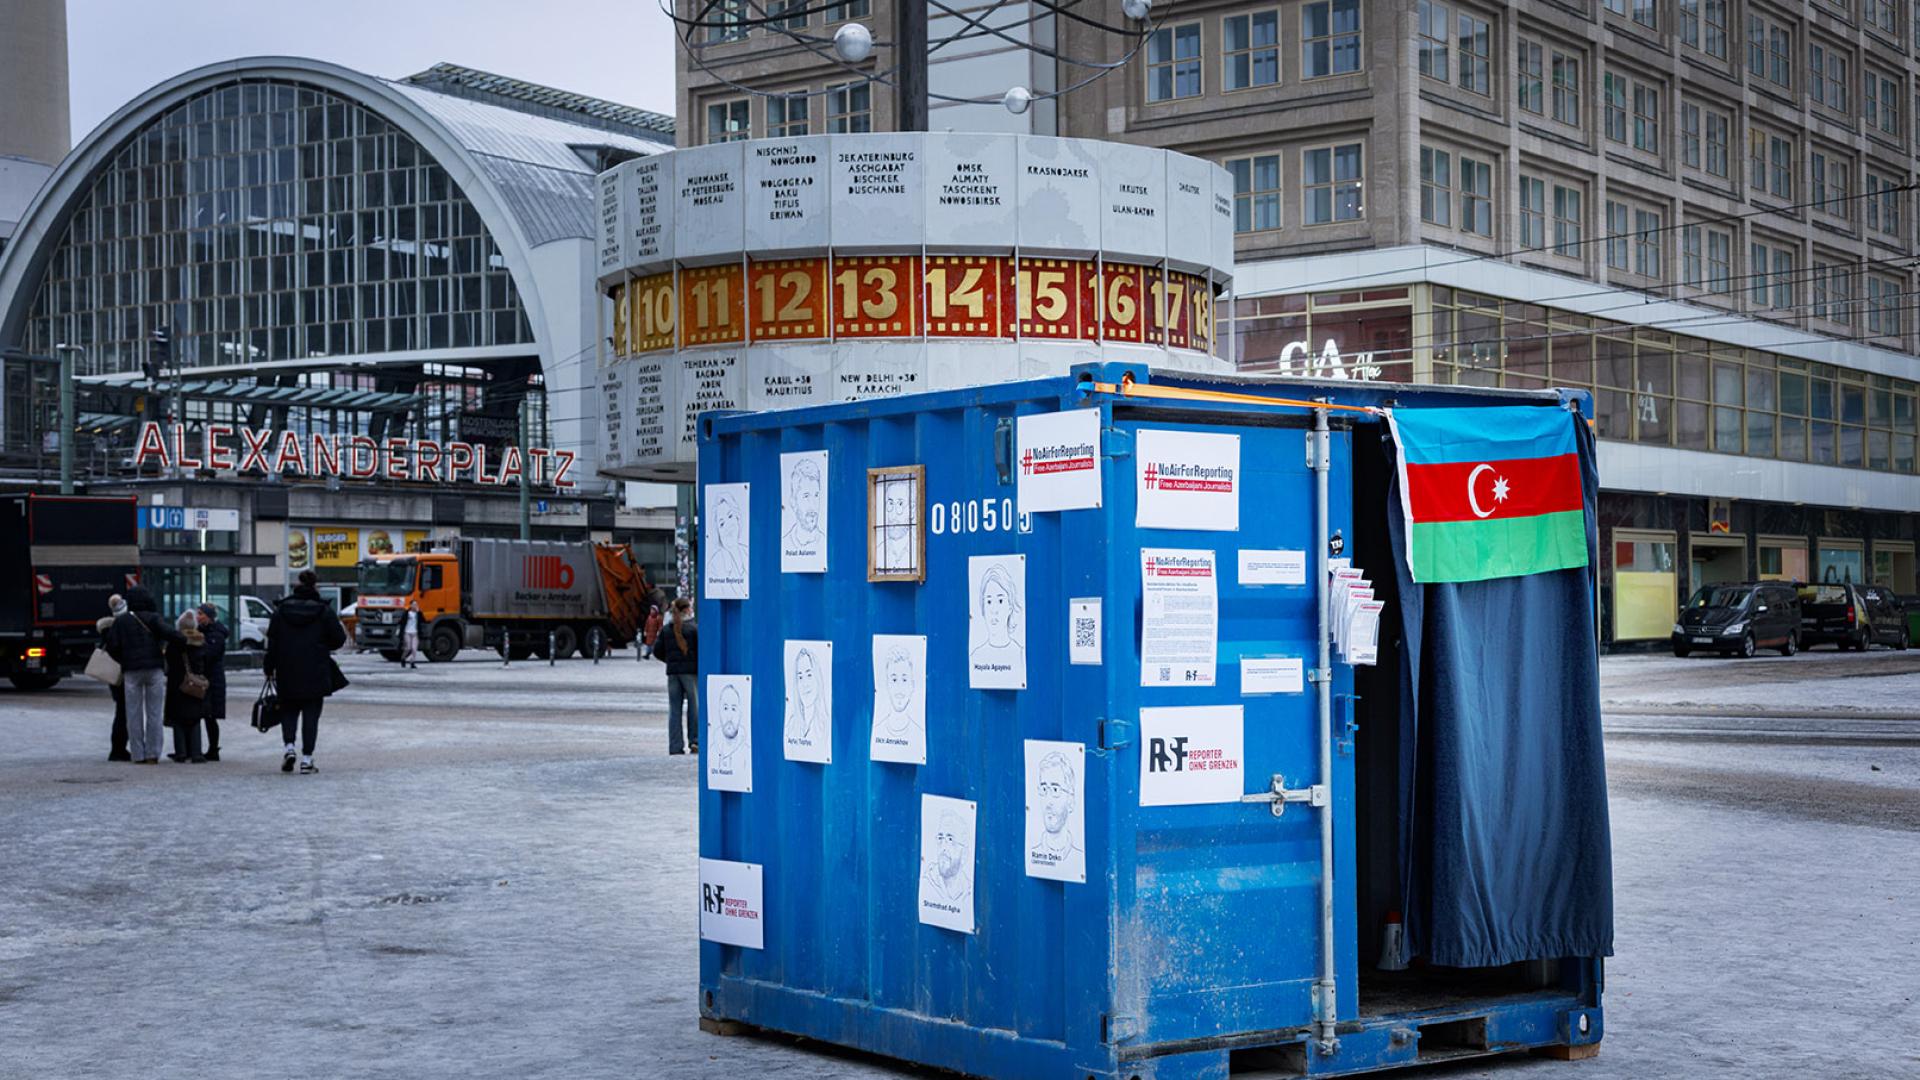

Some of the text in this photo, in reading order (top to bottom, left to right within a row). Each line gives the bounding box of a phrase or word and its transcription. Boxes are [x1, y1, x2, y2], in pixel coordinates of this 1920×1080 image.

[757, 145, 798, 157] NISCHNIJ
[771, 155, 817, 166] NOWGOROD
[838, 152, 915, 163] JEKATERINBURG
[848, 163, 905, 173] ASCHGABAT
[956, 164, 982, 173] OMSK
[1027, 165, 1089, 178] KRASNOJARSK
[687, 173, 729, 186] MURMANSK
[760, 177, 814, 188] WOLGOGRAD
[952, 175, 989, 184] ALMATY
[775, 189, 799, 199] BAKU
[848, 185, 905, 194] DUSCHANBE
[943, 185, 998, 194] TASCHKENT
[1119, 183, 1149, 195] IRKUTSK
[693, 195, 724, 206] MOSKAU
[774, 199, 800, 209] TIFLIS
[939, 196, 1001, 206] NOWOSIBIRSK
[770, 210, 804, 220] ERIWAN
[1112, 204, 1155, 217] ULAN-BATOR
[755, 271, 813, 323] 12
[835, 267, 898, 319] 13
[926, 268, 984, 318] 14
[1011, 270, 1068, 321] 15
[692, 278, 729, 328] 11
[1088, 273, 1134, 325] 16
[1150, 280, 1184, 330] 17
[642, 285, 674, 337] 10
[1193, 289, 1210, 340] 18
[684, 360, 718, 369] TEHERAN
[695, 369, 725, 379] BAGDAD
[840, 374, 860, 383] NEW
[866, 374, 894, 382] DELHI
[700, 380, 721, 389] ADEN
[764, 376, 792, 385] KABUL
[766, 386, 813, 396] MAURITIUS
[857, 385, 902, 394] KARACHI
[696, 391, 724, 400] SANAA
[686, 400, 736, 411] ADDIS ABEBA
[135, 421, 577, 488] ALEXANDERPLATZ
[1023, 443, 1095, 475] #NoAirForReporting
[1144, 462, 1233, 489] #NoAirForReporting
[151, 508, 164, 528] U
[1149, 736, 1188, 773] RSF
[1189, 749, 1222, 760] REPORTER
[1188, 760, 1238, 771] OHNE GRENZEN
[703, 883, 725, 914] RSF
